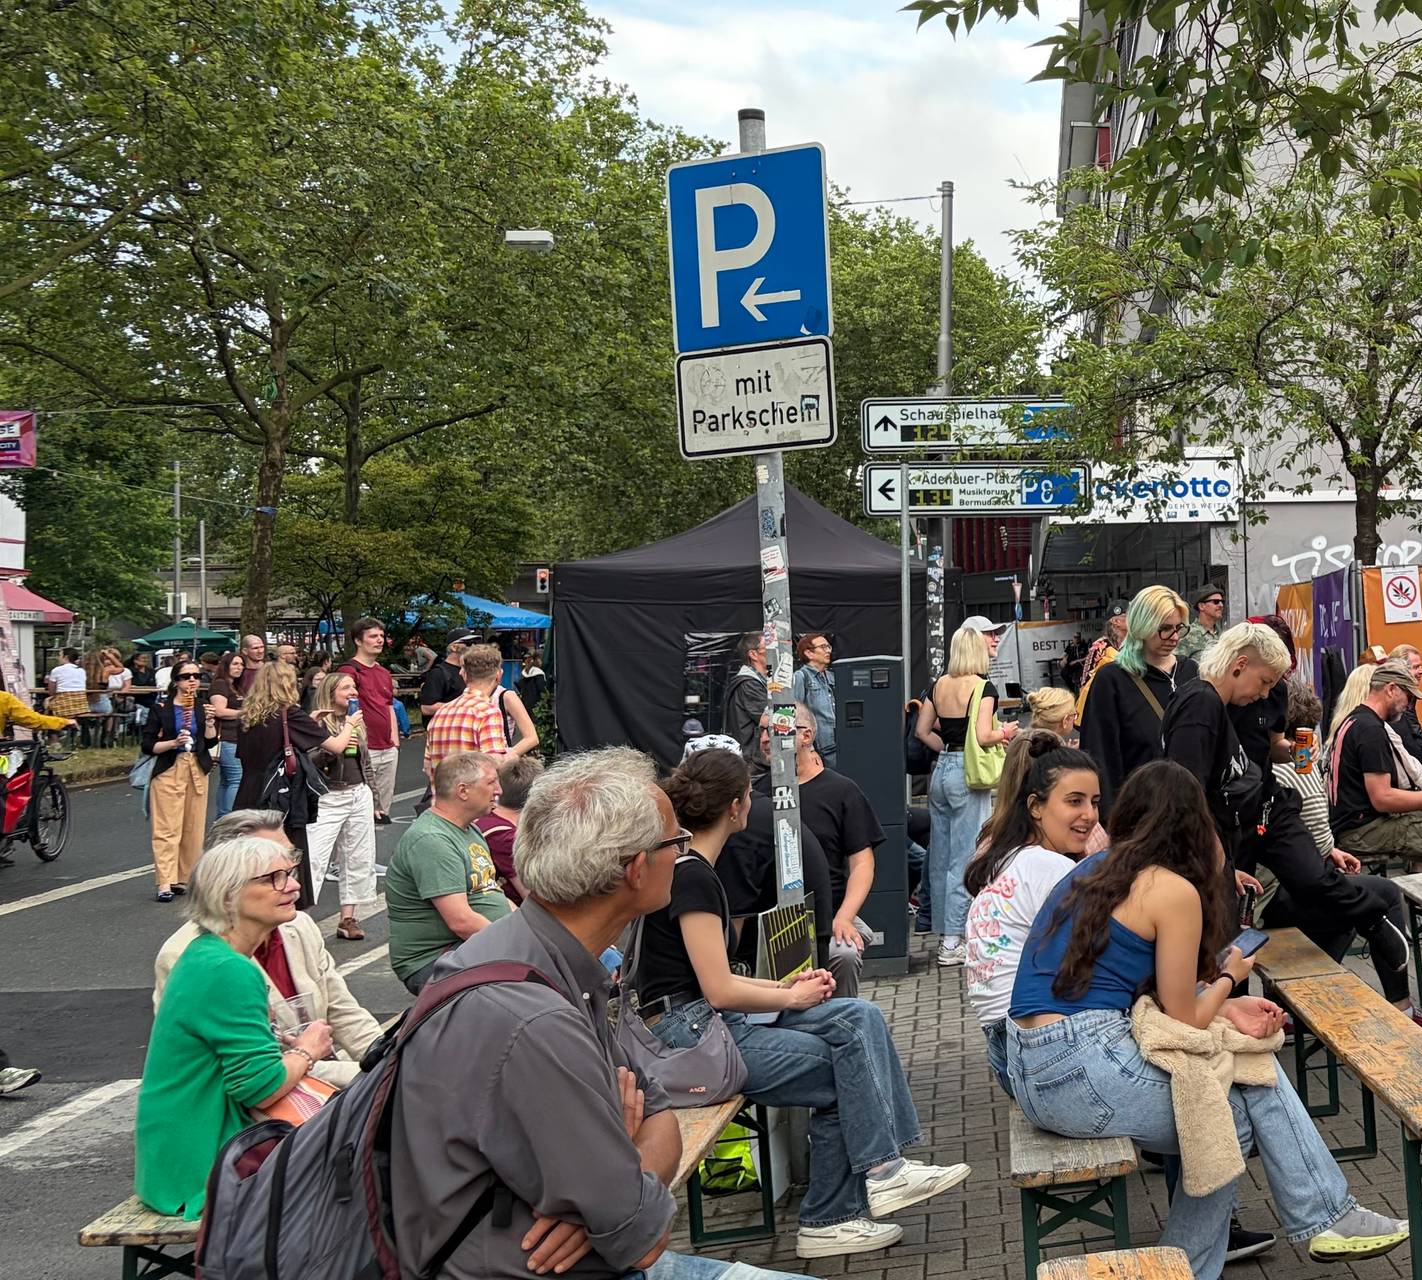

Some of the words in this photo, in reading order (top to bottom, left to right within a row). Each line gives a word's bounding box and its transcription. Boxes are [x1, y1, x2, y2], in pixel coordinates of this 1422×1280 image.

[695, 182, 777, 328] P
[735, 370, 772, 396] mit
[1032, 640, 1058, 651] BEST
